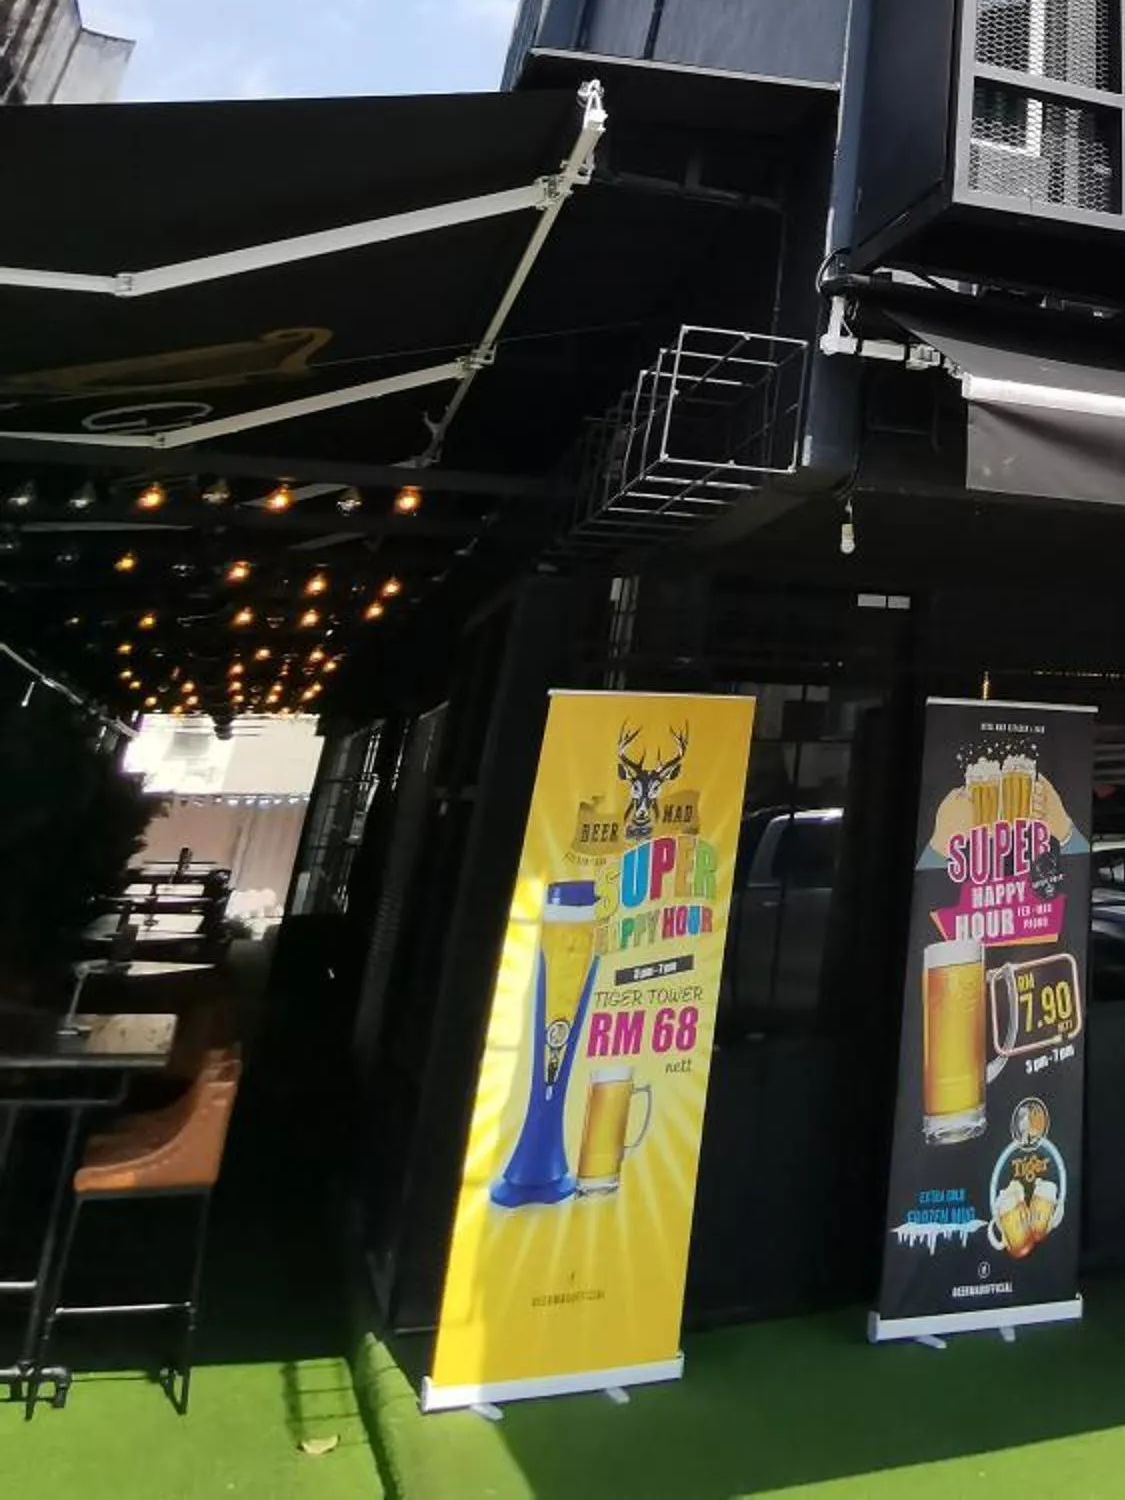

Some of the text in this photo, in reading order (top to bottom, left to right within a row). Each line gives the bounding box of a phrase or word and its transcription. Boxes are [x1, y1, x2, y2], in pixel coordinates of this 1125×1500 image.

[580, 803, 693, 843] BEER MAD
[947, 818, 1051, 885] SUPER
[971, 880, 1027, 909] HAPPY
[662, 905, 713, 940] HOUR
[955, 907, 1016, 941] HOUR
[595, 985, 704, 1008] TIGER TOWER
[1017, 972, 1036, 992] RM
[1019, 981, 1073, 1032] 7.90
[586, 1005, 699, 1057] RM 68
[1011, 1155, 1050, 1182] Tiger
